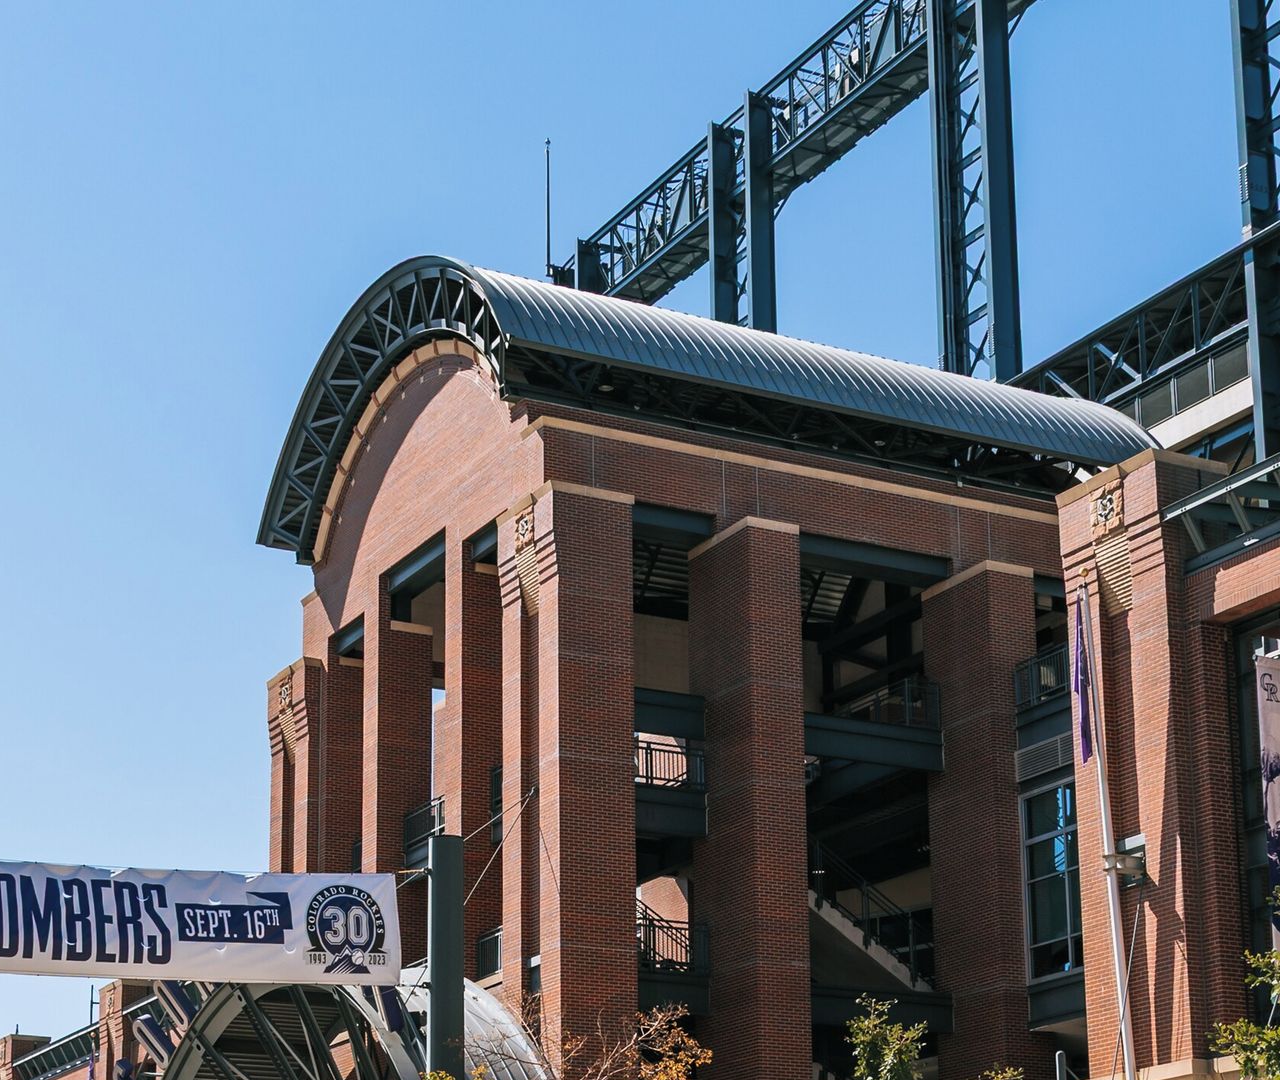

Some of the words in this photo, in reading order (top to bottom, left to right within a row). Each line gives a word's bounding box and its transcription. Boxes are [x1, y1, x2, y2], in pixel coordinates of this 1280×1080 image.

[183, 908, 238, 938] SEPT.
[308, 886, 346, 932] COLORADO
[351, 888, 384, 935] ROCKIES
[322, 905, 370, 946] 30
[309, 953, 327, 965] 1993
[368, 954, 386, 966] 2023
